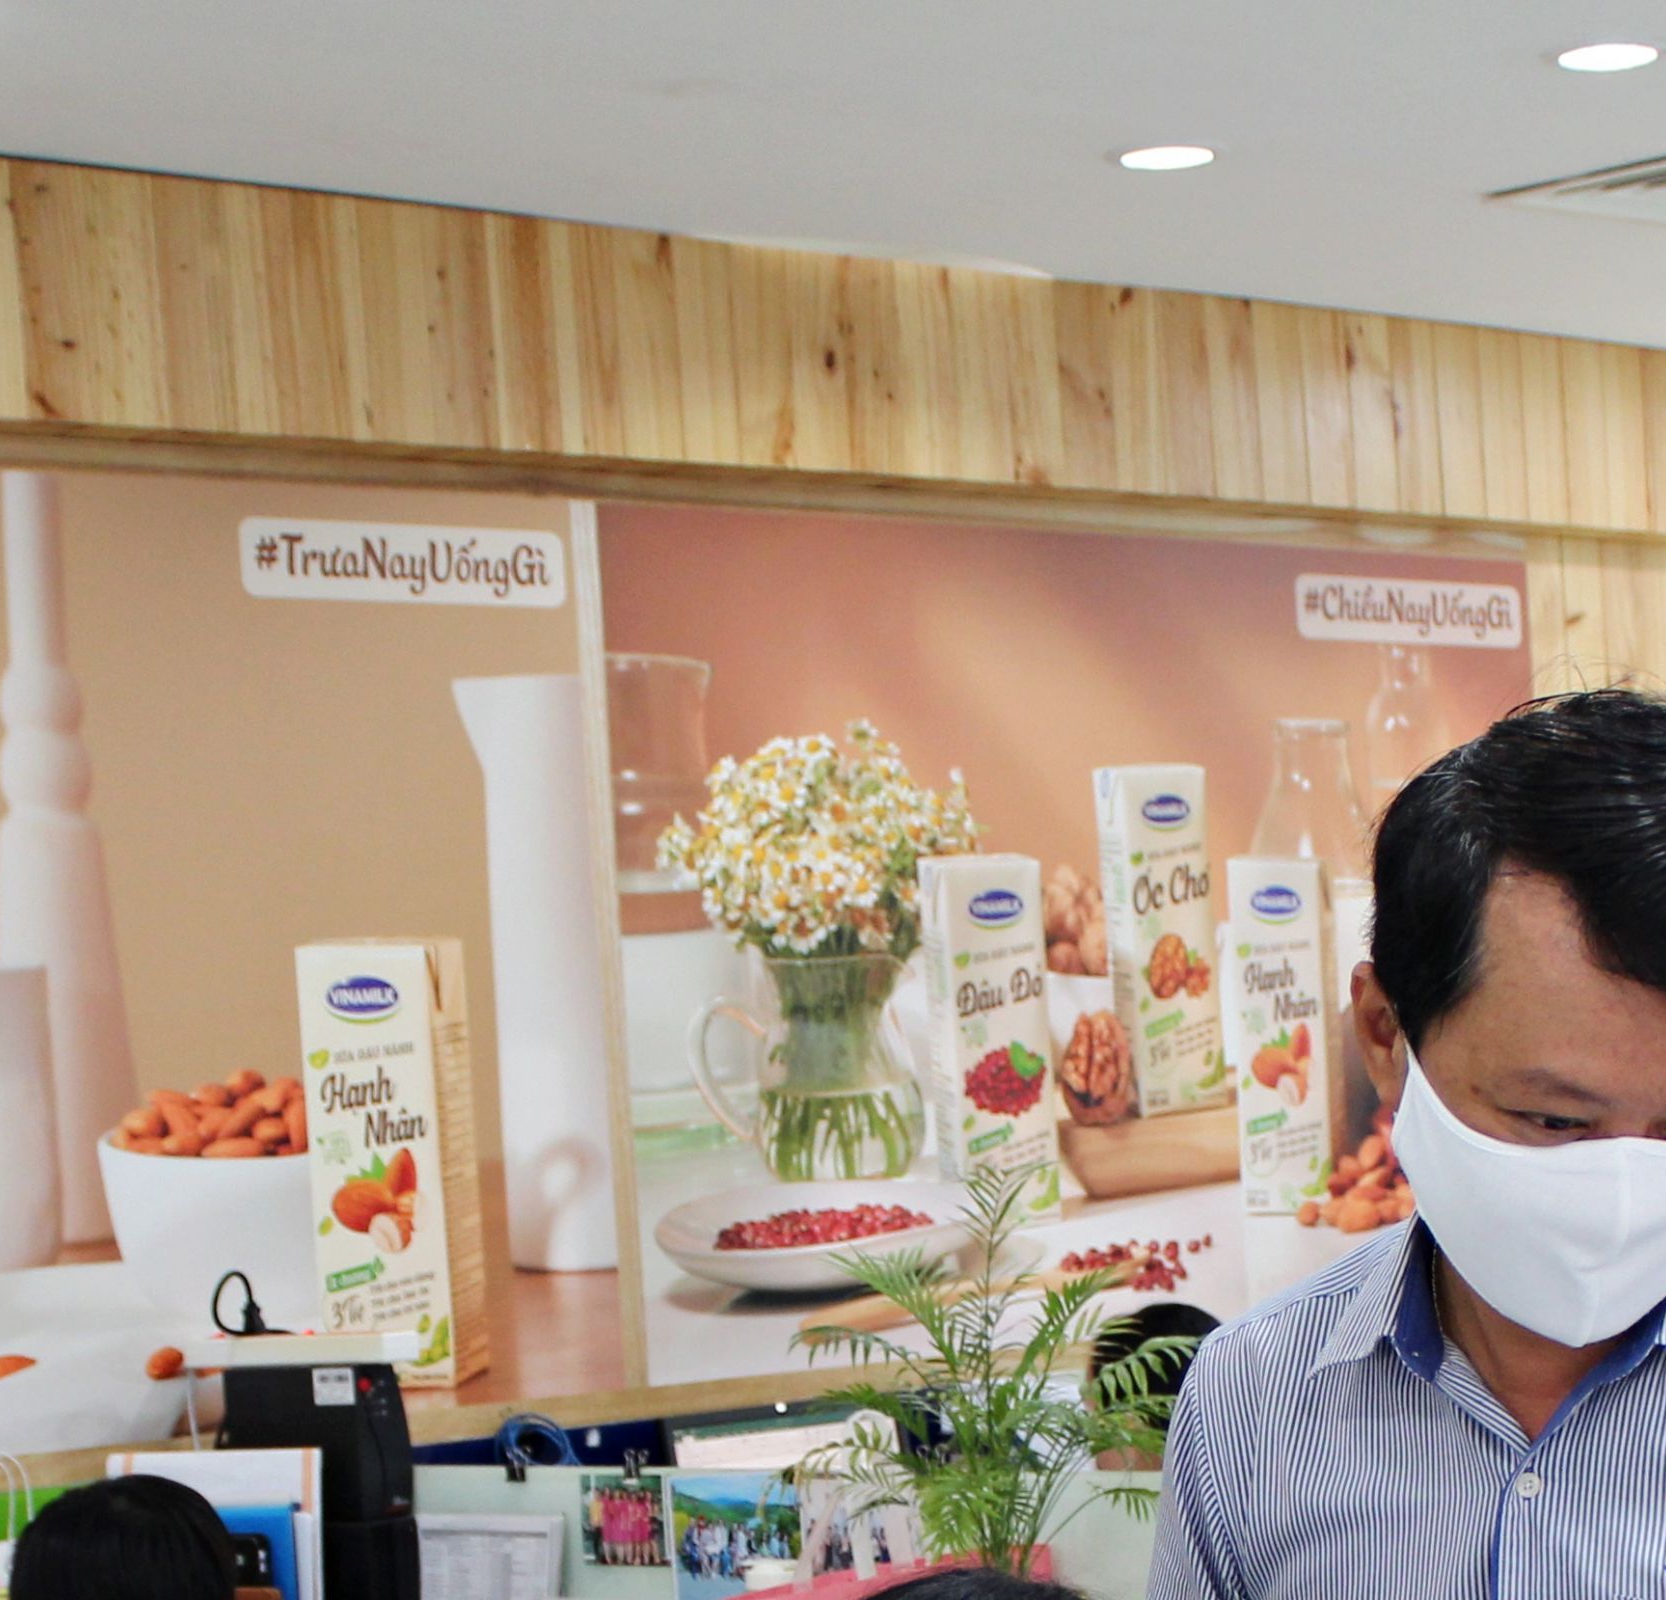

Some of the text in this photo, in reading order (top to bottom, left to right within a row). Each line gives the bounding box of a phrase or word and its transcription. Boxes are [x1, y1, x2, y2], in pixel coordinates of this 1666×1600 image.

[255, 533, 550, 597] #TrưaNayUốngGì
[321, 1065, 393, 1116] Hạnh
[364, 1106, 427, 1148] Nhân
